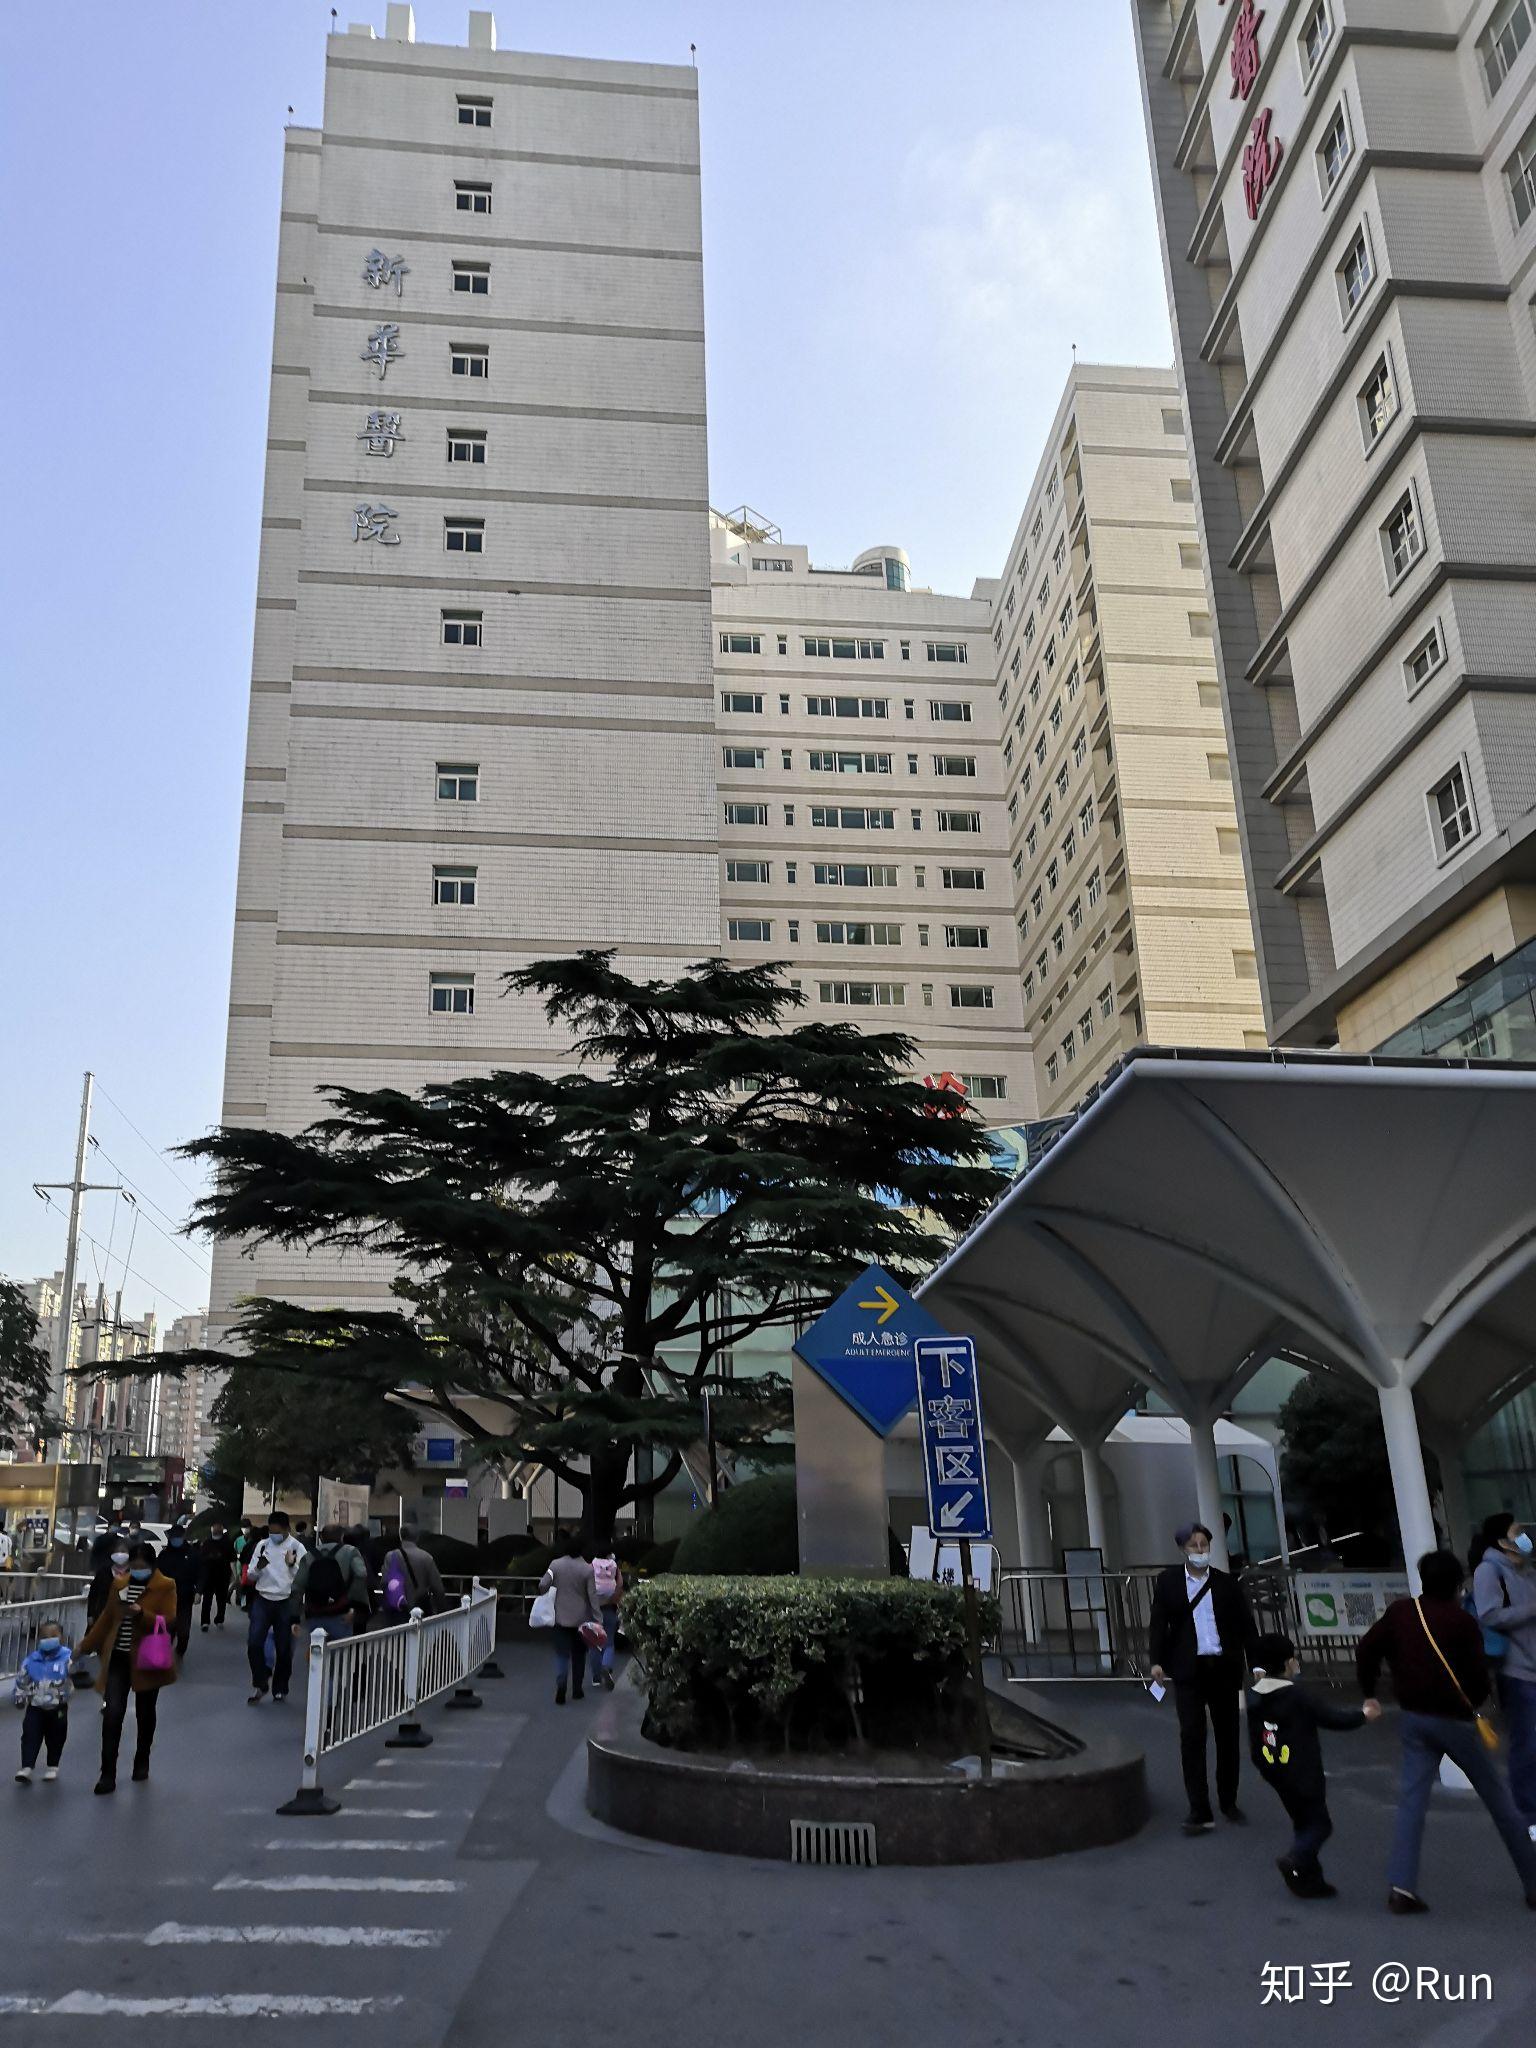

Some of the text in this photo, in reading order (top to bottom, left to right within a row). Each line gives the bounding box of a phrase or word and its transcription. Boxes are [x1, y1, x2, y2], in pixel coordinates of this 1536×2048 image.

[852, 1331, 908, 1347] 成人急诊
[920, 1346, 979, 1486] 下客区
